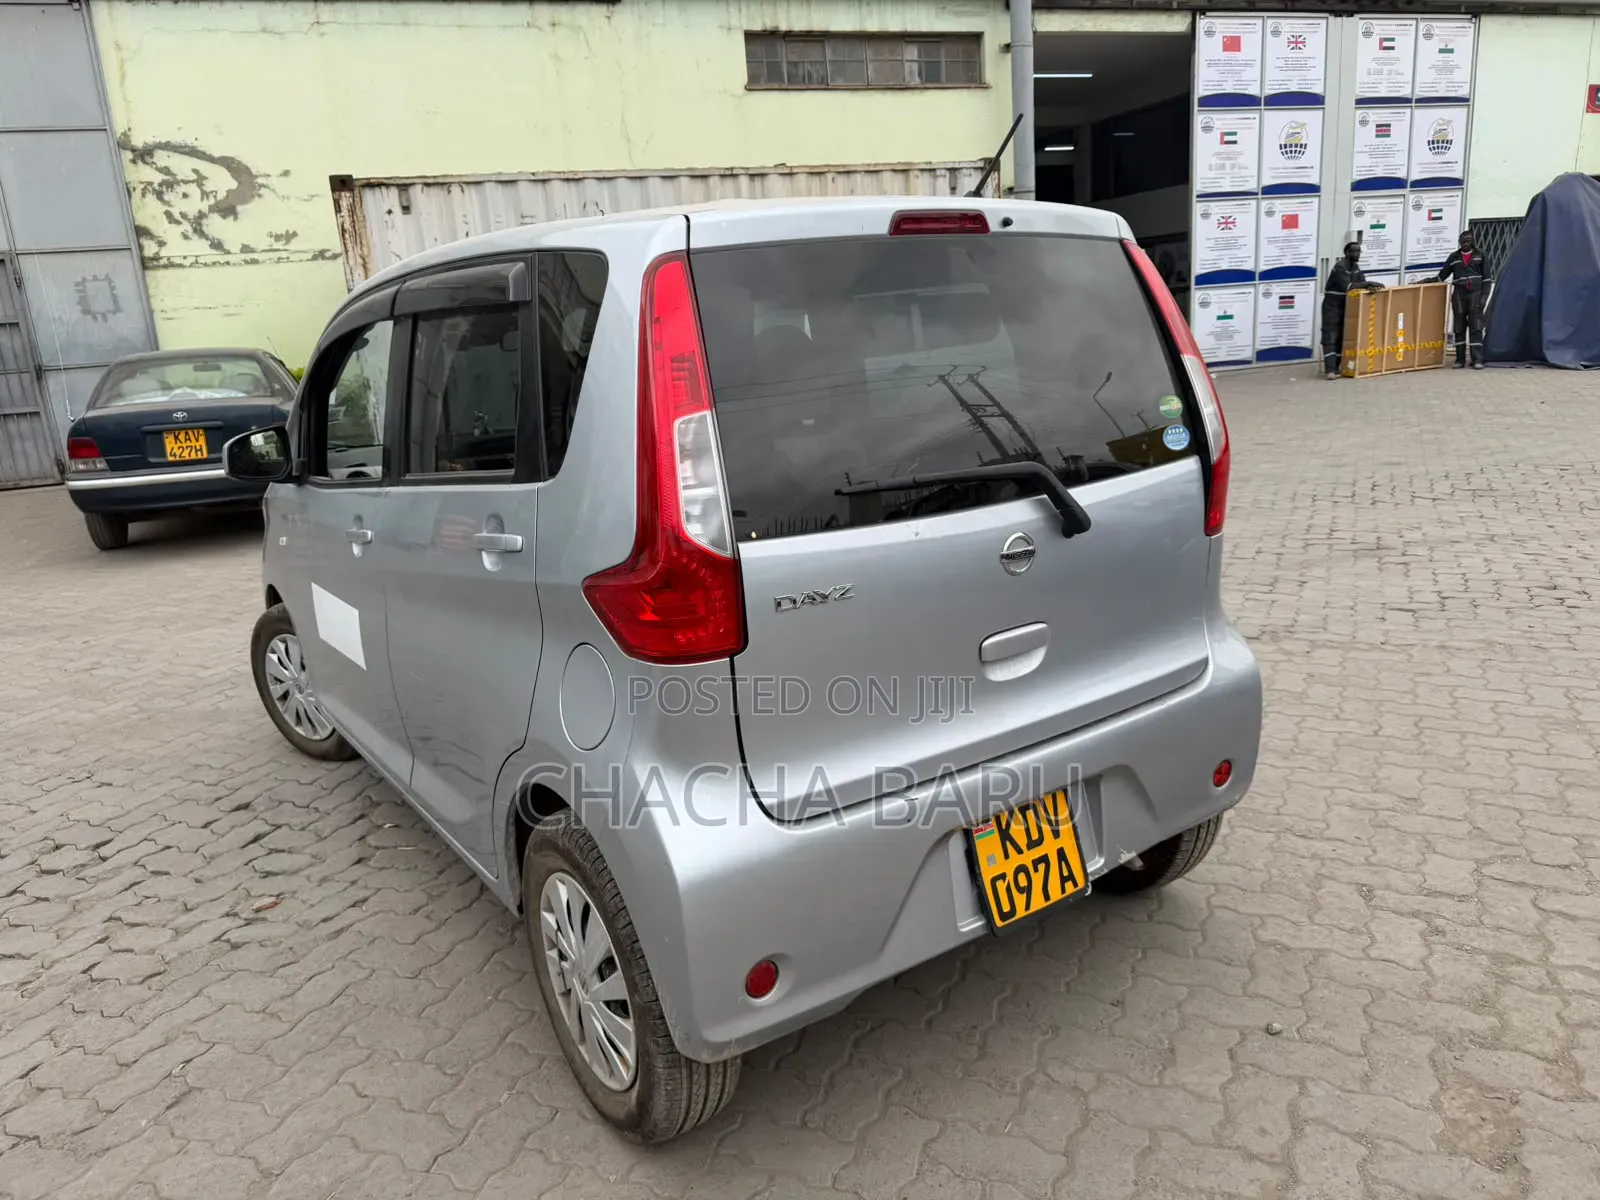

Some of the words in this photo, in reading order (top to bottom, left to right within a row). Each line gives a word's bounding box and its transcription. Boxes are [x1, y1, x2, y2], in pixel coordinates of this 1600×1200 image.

[173, 430, 200, 444] KAV
[169, 445, 204, 459] 427H
[774, 583, 855, 612] DAYZ
[994, 791, 1061, 861] KDV
[990, 846, 1079, 922] 097A
